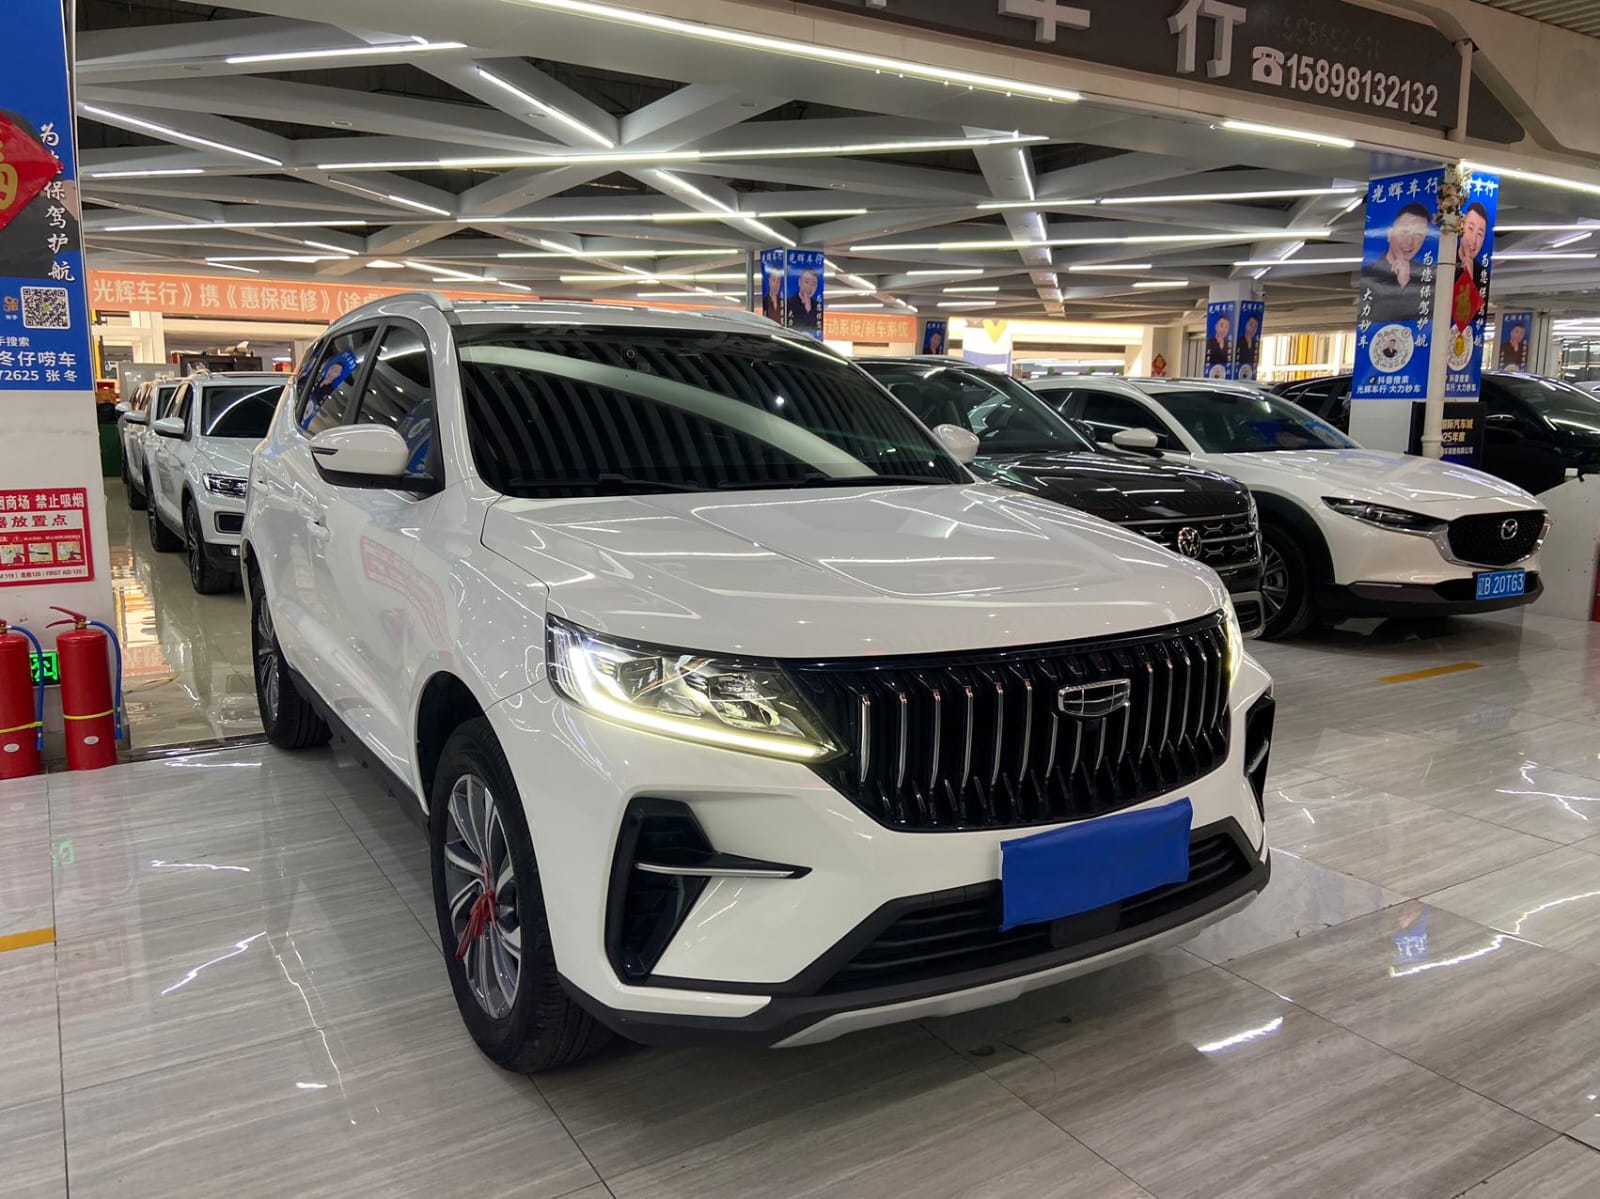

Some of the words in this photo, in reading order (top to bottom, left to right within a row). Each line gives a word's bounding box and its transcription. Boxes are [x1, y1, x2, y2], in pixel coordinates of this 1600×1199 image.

[1287, 53, 1439, 117] 15898132132
[40, 122, 75, 281] 为保驾护航
[1371, 177, 1439, 204] 光辉车行
[1414, 251, 1433, 348] 为您保驾护航
[45, 369, 78, 382] 张冬
[36, 493, 84, 509] 禁止吸烟
